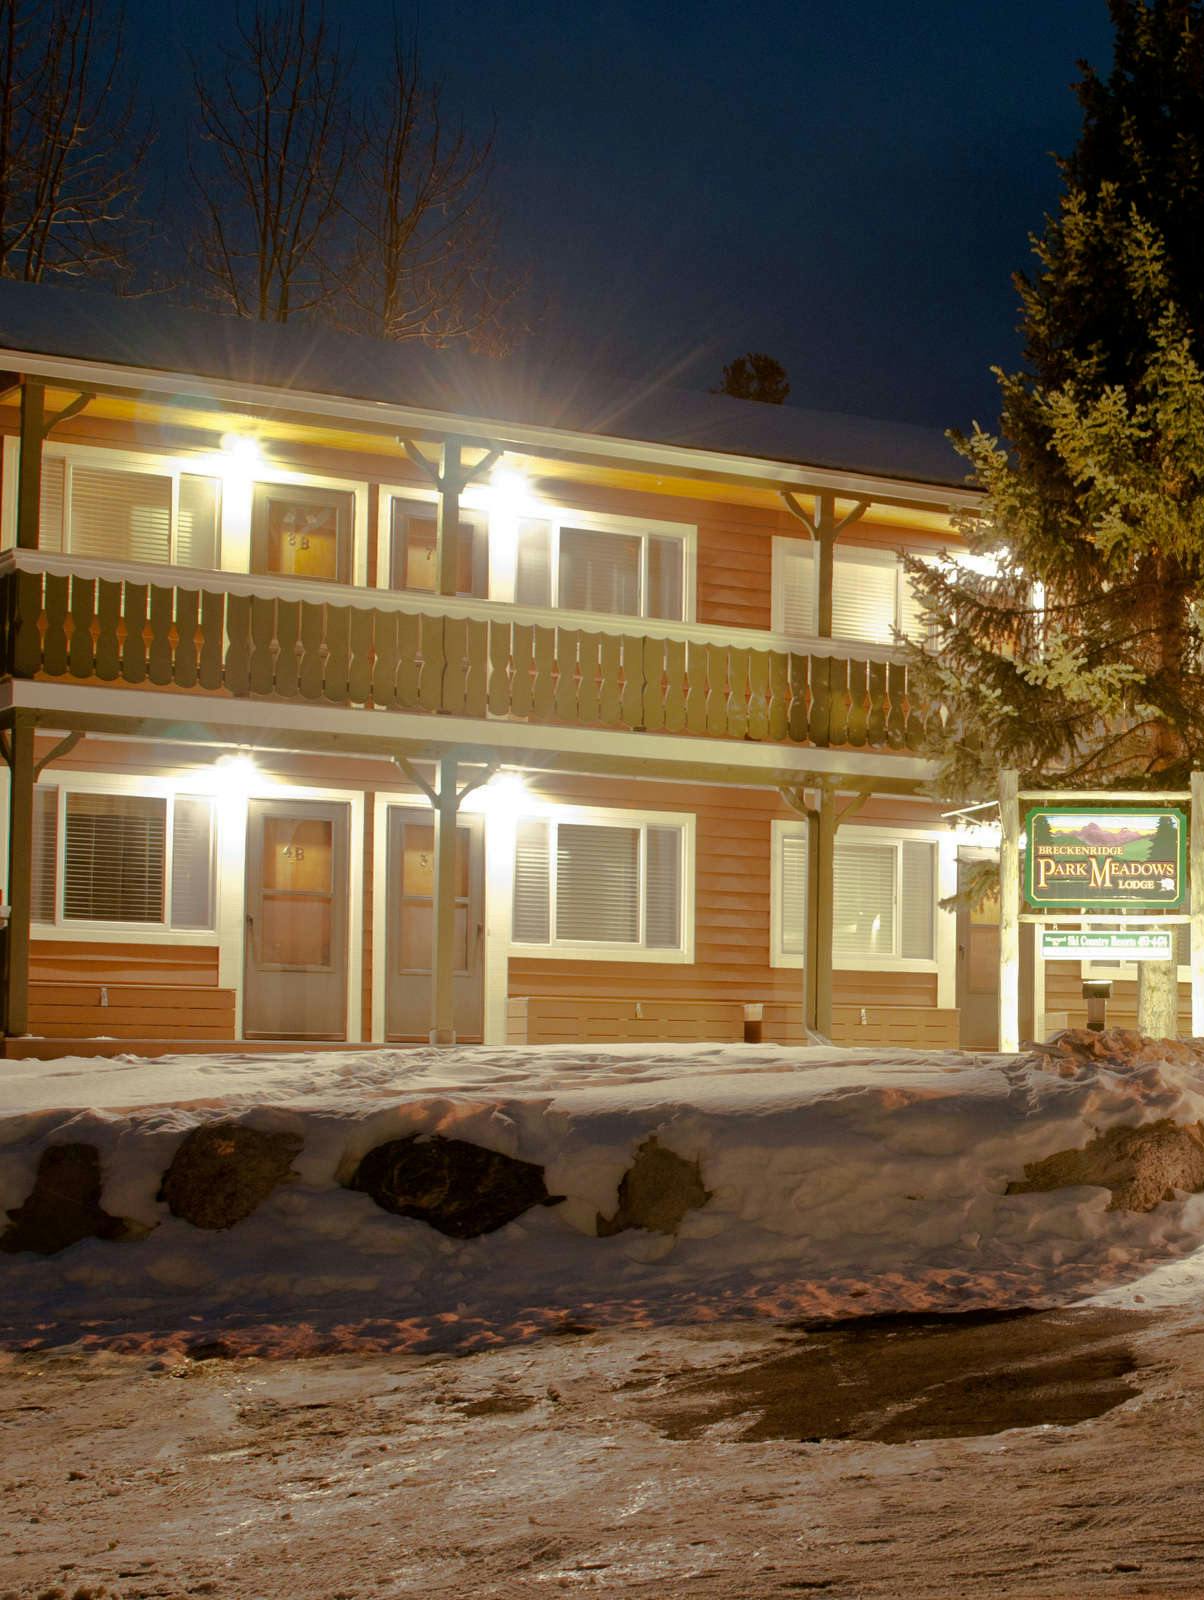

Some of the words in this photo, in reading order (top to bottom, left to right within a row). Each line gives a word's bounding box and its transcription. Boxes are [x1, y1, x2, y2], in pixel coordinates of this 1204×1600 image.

[1038, 846, 1124, 855] BRECKENRIDGE
[1038, 858, 1088, 888] PARK
[1089, 857, 1175, 888] MEADOWS
[1118, 880, 1155, 889] LODGE
